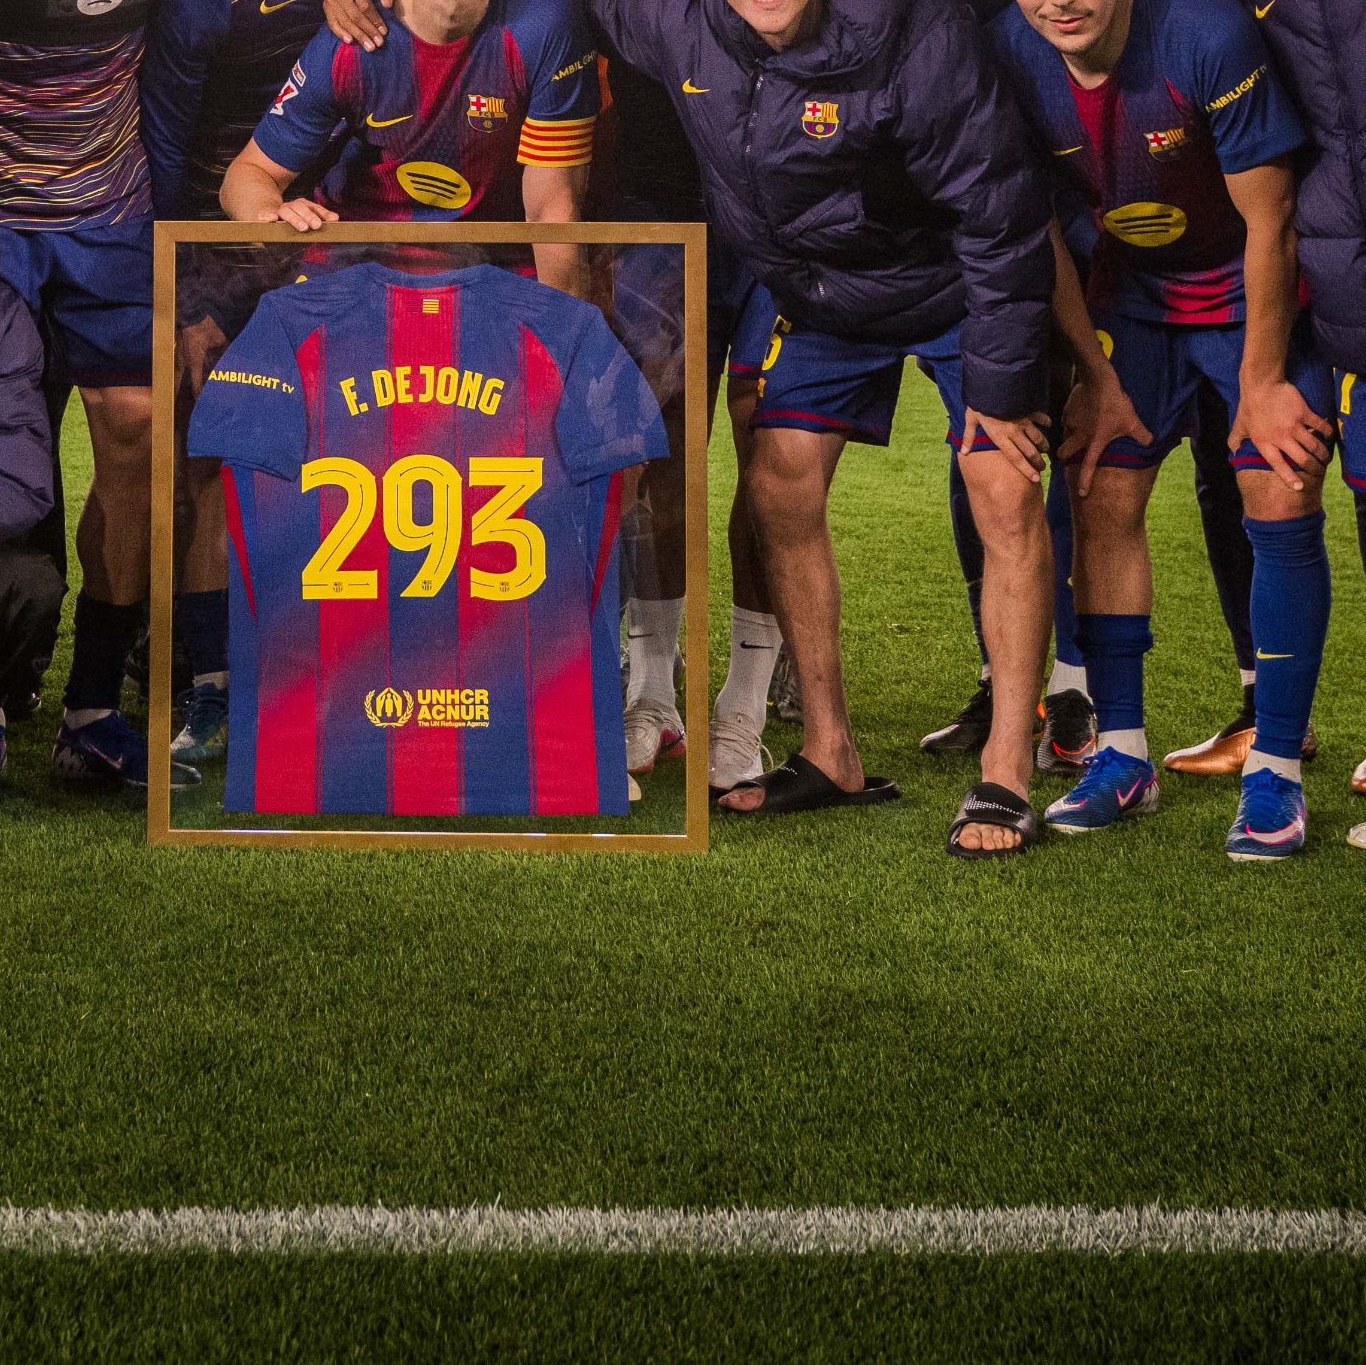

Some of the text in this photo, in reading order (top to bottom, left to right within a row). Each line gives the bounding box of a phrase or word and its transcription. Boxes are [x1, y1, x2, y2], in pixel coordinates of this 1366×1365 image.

[208, 369, 295, 394] AMBILIGHT tv
[339, 365, 505, 417] F. DE JONG
[301, 454, 547, 601] 293
[417, 688, 490, 705] UNHCR
[417, 704, 490, 721] ACNUR
[441, 720, 465, 728] Refugee
[467, 720, 490, 728] Agency
